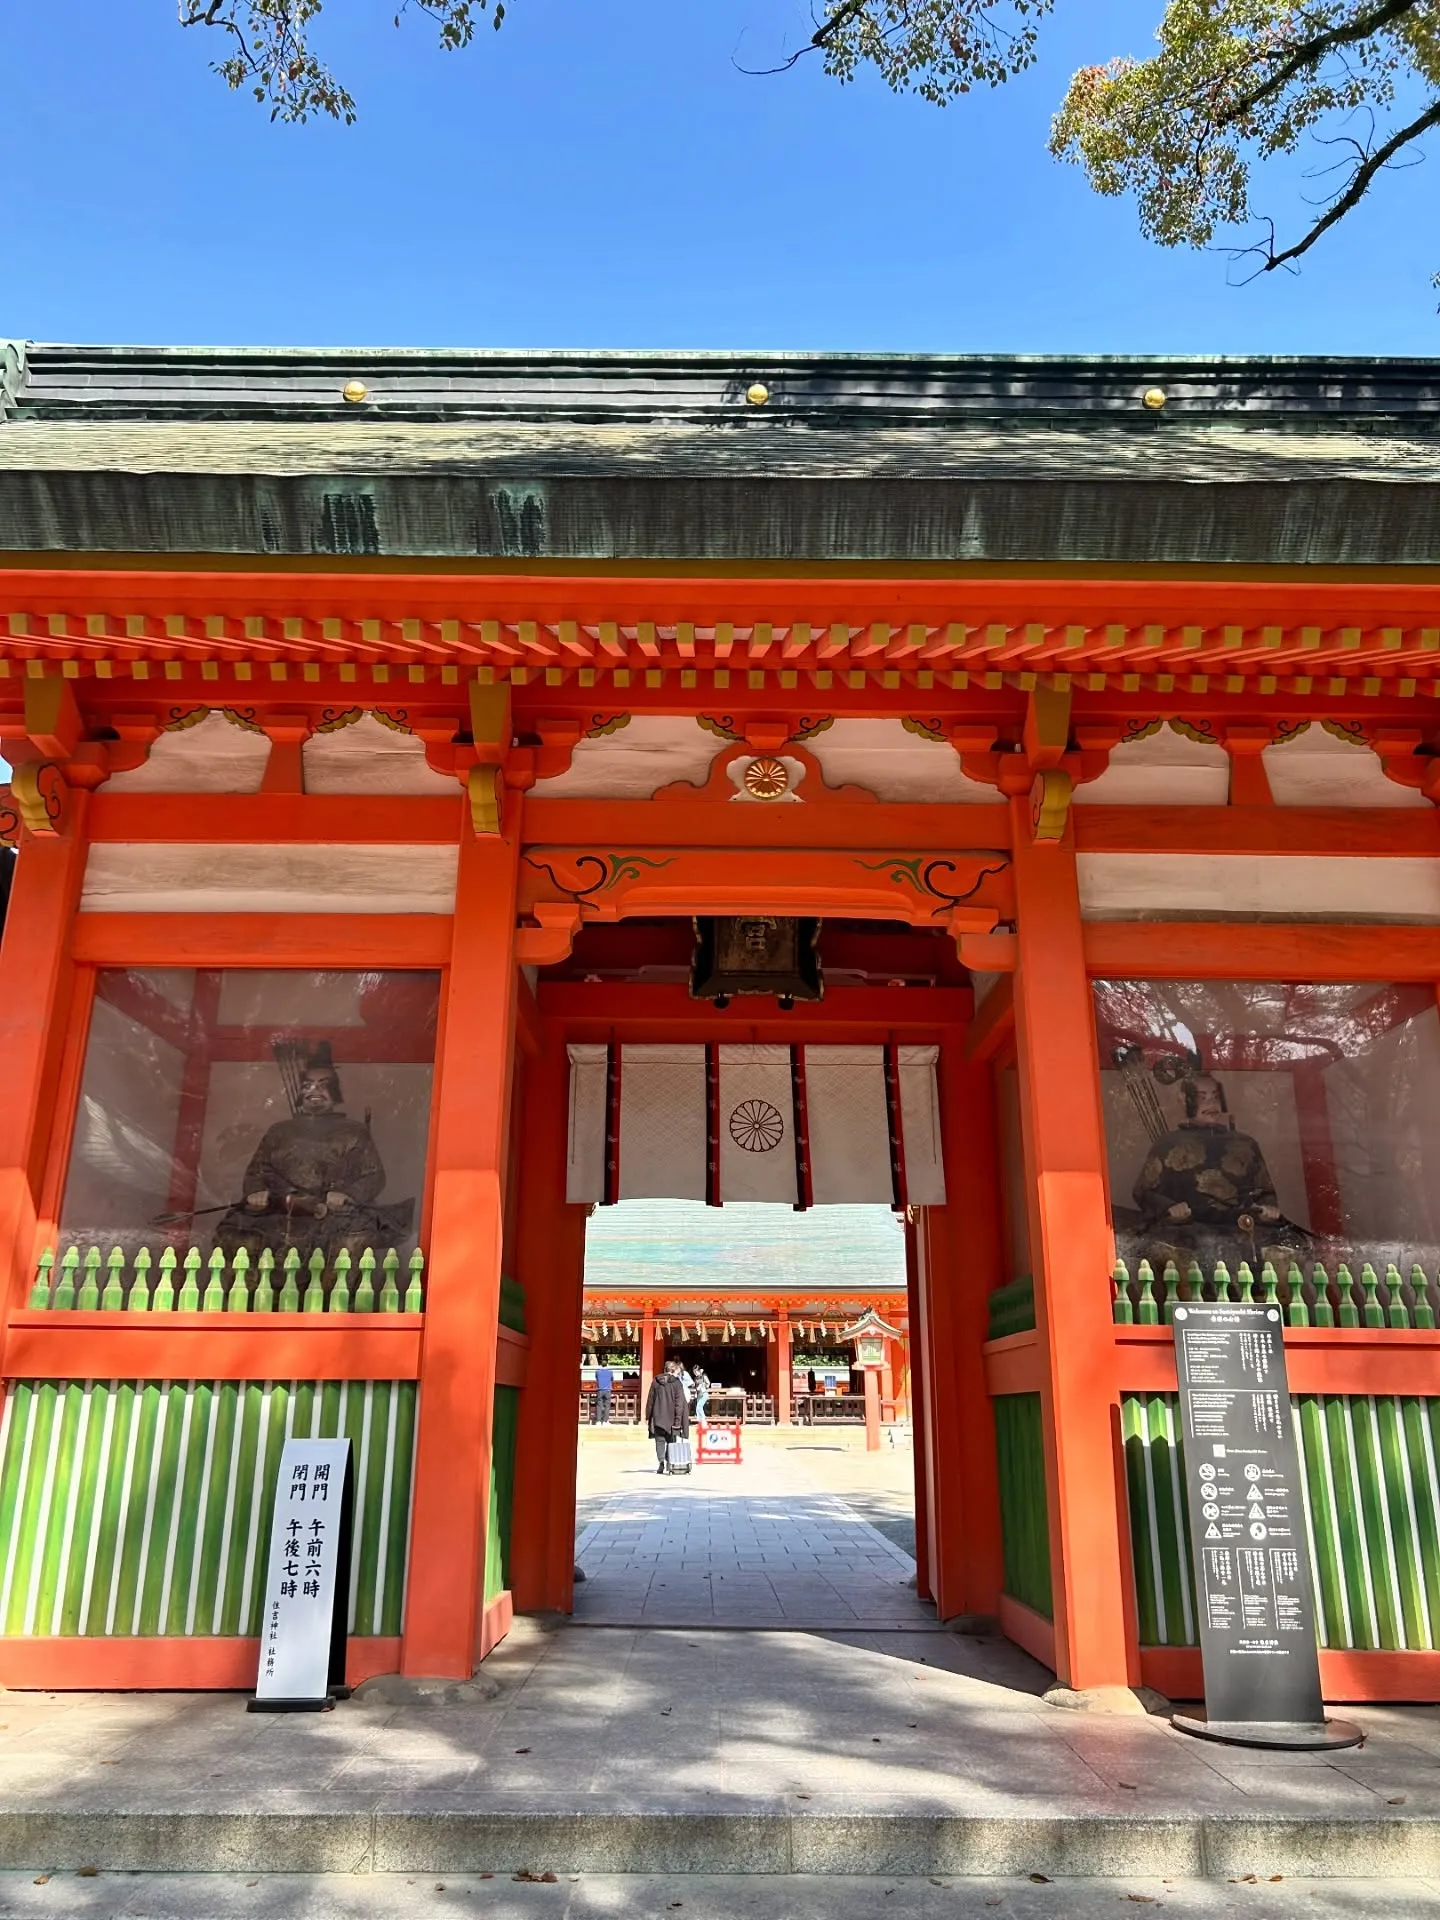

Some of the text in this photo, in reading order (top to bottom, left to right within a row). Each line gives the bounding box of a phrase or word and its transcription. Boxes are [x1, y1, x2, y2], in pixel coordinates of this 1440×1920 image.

[281, 1463, 309, 1599] 閉門 午後七時
[303, 1463, 331, 1599] 開門 午前六時
[270, 1601, 281, 1640] 住吉神社
